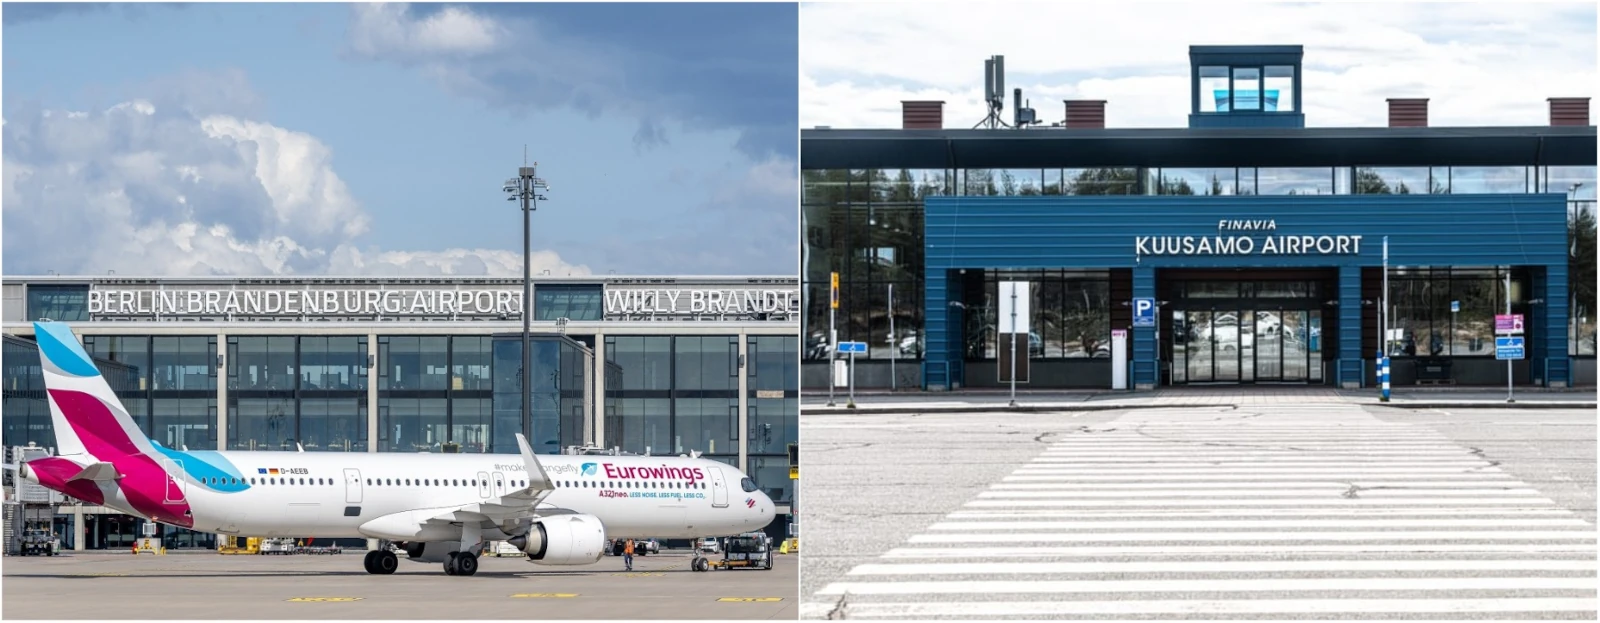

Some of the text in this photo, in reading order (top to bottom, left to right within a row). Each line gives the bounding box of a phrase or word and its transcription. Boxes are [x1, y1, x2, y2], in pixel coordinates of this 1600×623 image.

[1218, 219, 1276, 230] FINAVIA
[1136, 235, 1362, 255] KUUSAMO AIRPORT
[88, 290, 794, 313] BERLIN BRANDENBURG AIRPORT WILLY BRANDT
[1137, 300, 1151, 316] P
[280, 467, 309, 475] D-AEEB
[494, 463, 579, 474] #makeangefly
[602, 463, 704, 485] Eurowings
